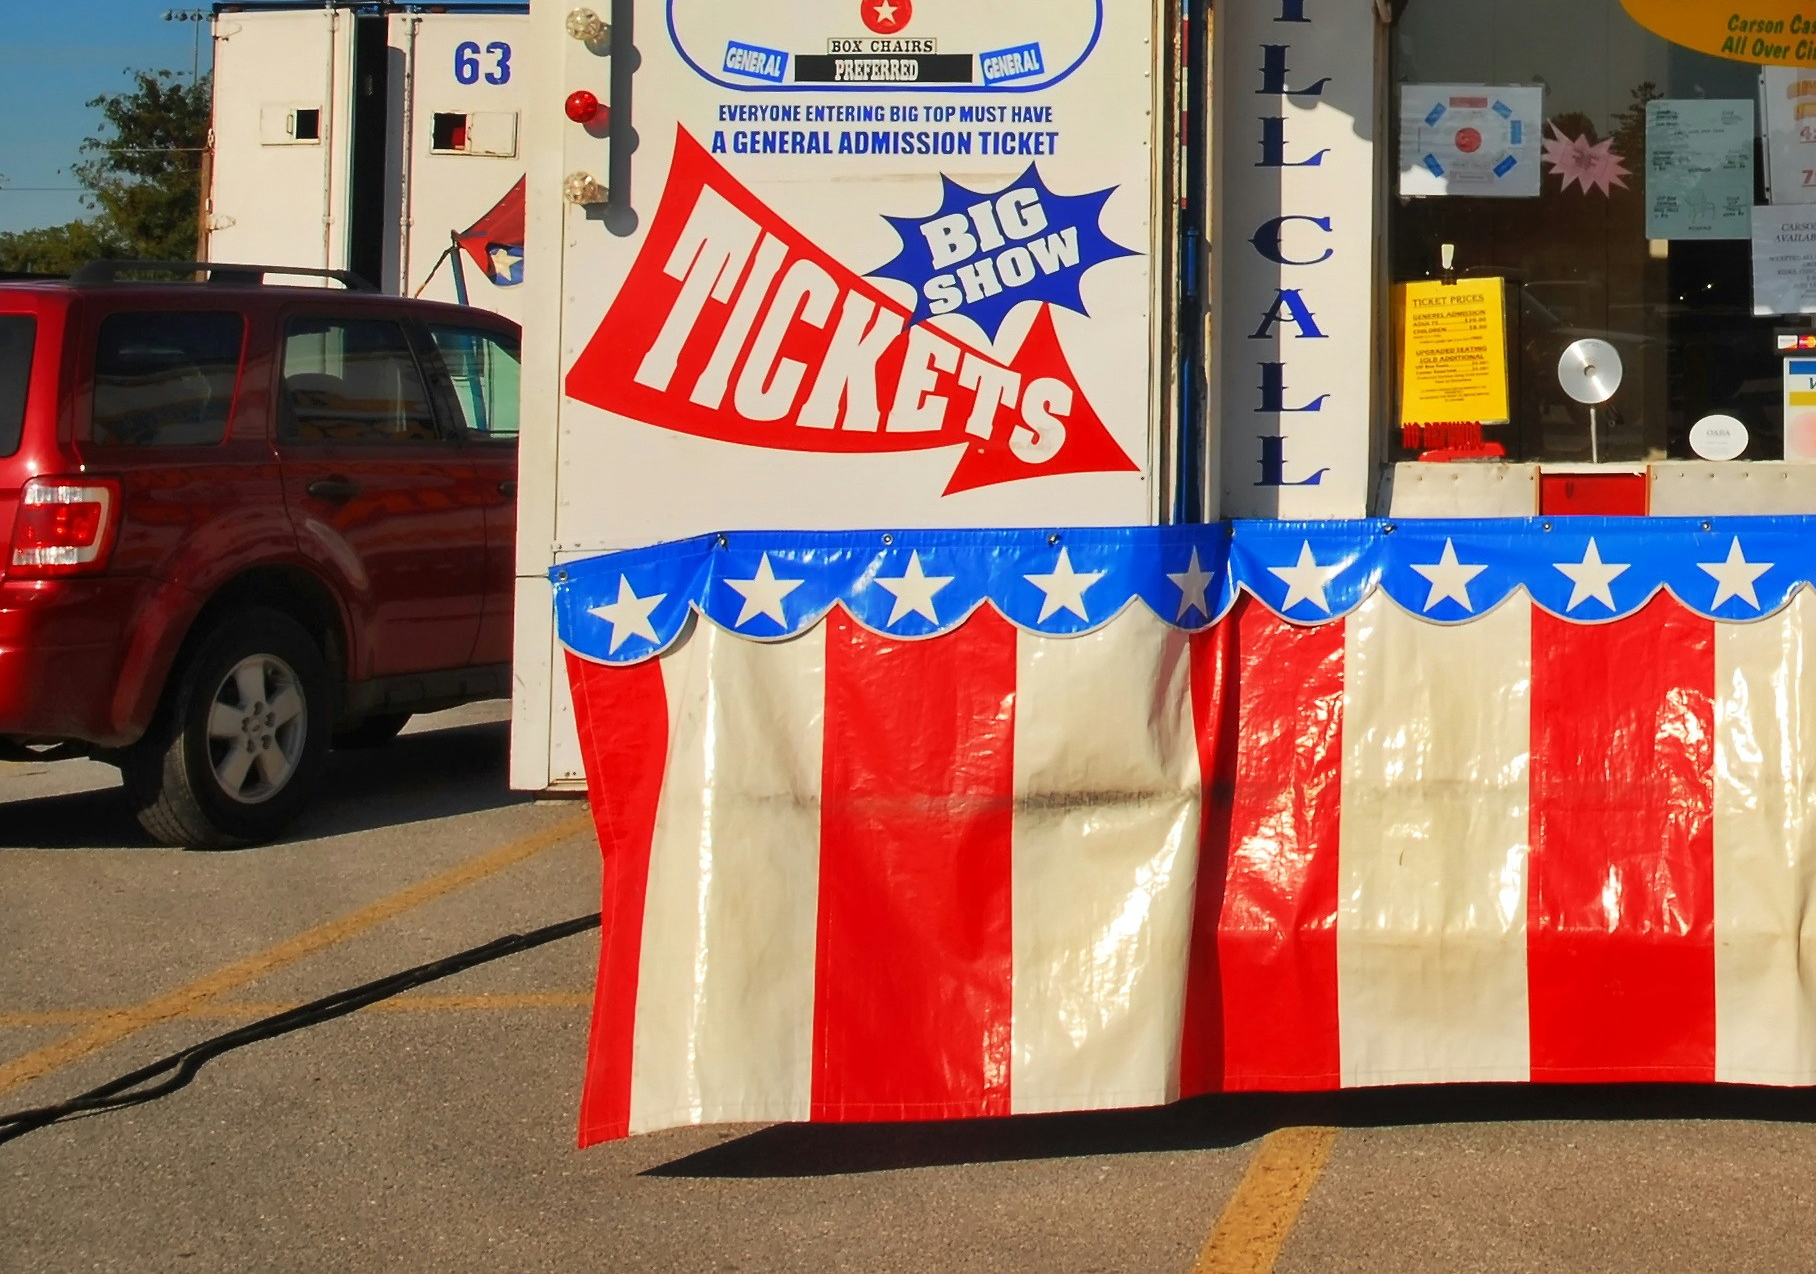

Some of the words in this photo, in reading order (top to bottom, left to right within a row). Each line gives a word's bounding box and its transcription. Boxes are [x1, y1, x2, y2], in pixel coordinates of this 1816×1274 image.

[1727, 13, 1784, 34] Carson
[831, 39, 863, 53] BOX
[870, 39, 933, 53] CHAIRS
[1721, 35, 1747, 55] All
[1752, 40, 1790, 60] Over
[455, 41, 512, 85] 63
[726, 45, 781, 78] GENERAL
[834, 58, 918, 80] PREFERRED
[983, 48, 1040, 80] GENERAL
[719, 104, 800, 122] EVERYONE
[805, 104, 886, 122] ENTERING
[889, 104, 918, 122] BIG
[923, 104, 955, 122] TOP
[959, 104, 1006, 122] MUST
[1010, 104, 1053, 122] HAVE
[712, 132, 728, 155] A
[733, 132, 834, 155] GENERAL
[838, 132, 972, 155] ADMISSION
[979, 132, 1058, 155] TICKET
[921, 188, 1049, 270] BIG
[923, 227, 1079, 317] SHOW
[1413, 296, 1447, 307] TICKET
[1450, 293, 1484, 304] PRICES
[634, 183, 1073, 464] TICKETS
[1247, 215, 1334, 487] CALL
